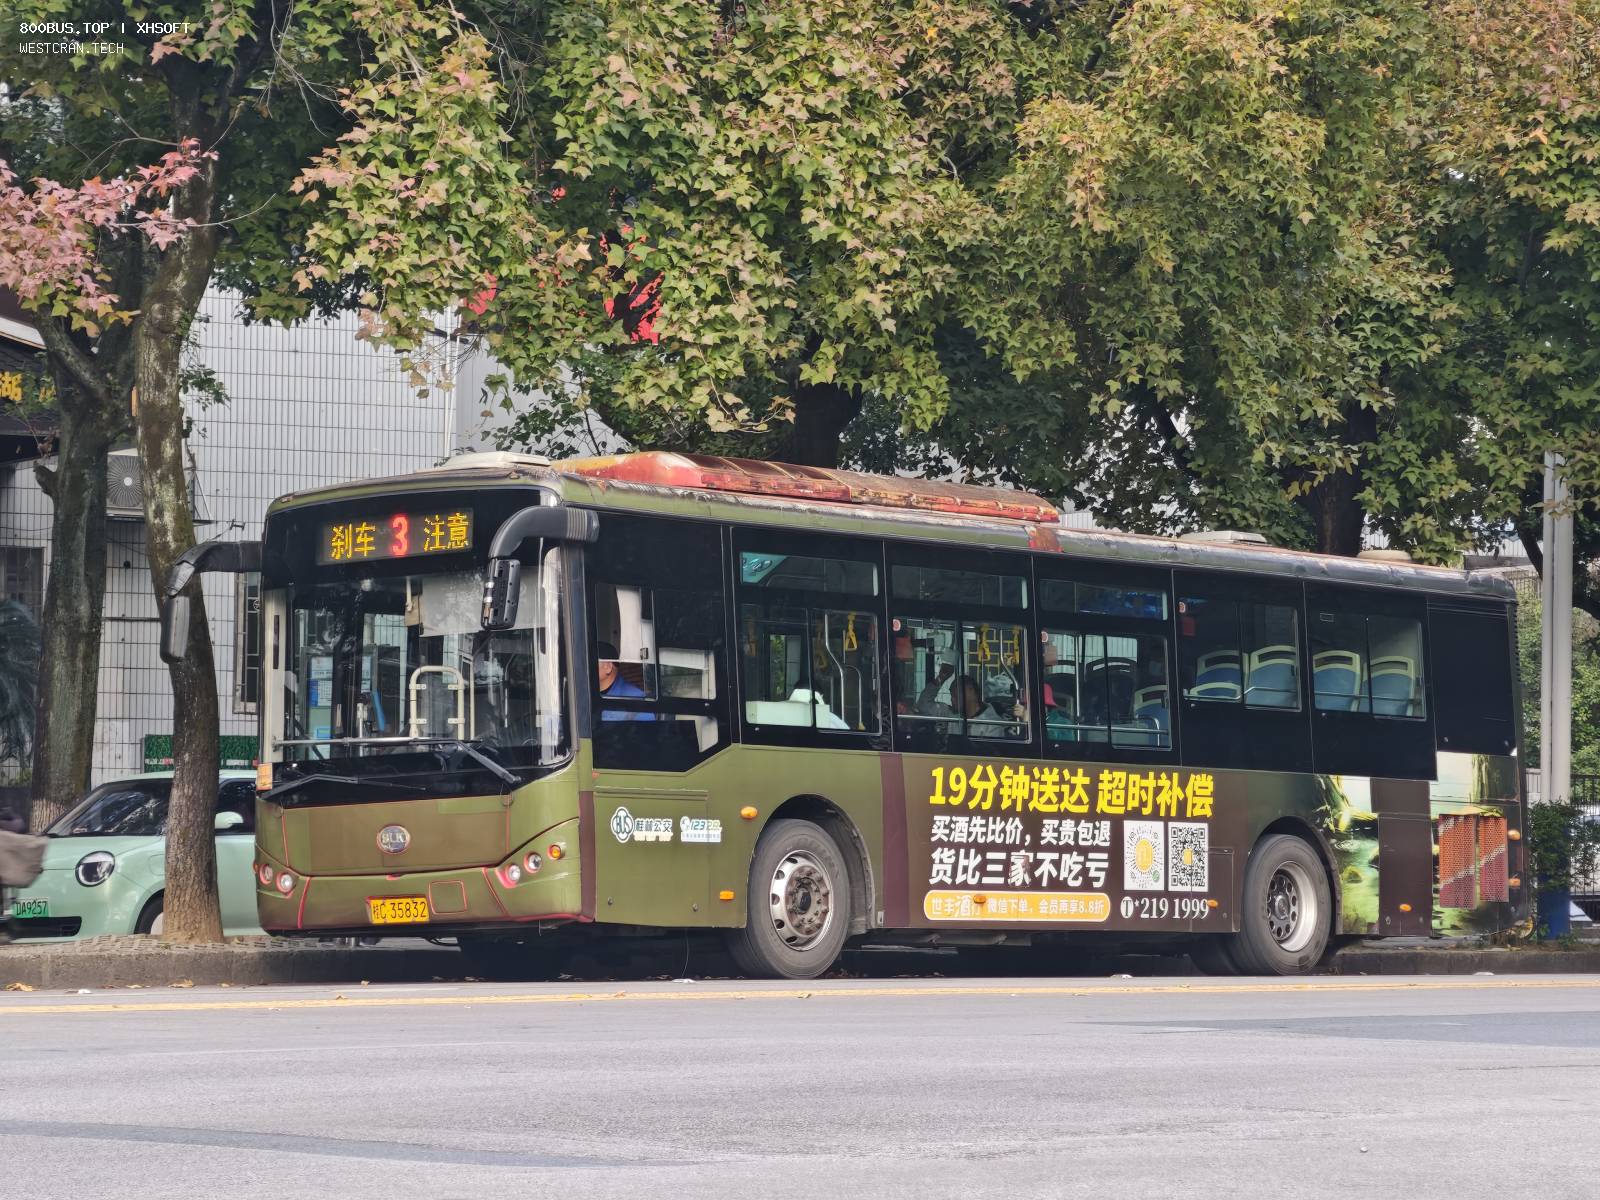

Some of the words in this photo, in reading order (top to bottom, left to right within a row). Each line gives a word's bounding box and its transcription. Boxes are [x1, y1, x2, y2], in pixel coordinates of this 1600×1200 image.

[331, 521, 376, 560] 刹车
[391, 515, 408, 557] 3
[423, 512, 469, 552] 注意
[929, 764, 1090, 813] 19分钟送达
[1096, 769, 1213, 818] 超时补偿
[929, 847, 1110, 888] 货比三家不吃亏
[1172, 898, 1209, 919] 1999
